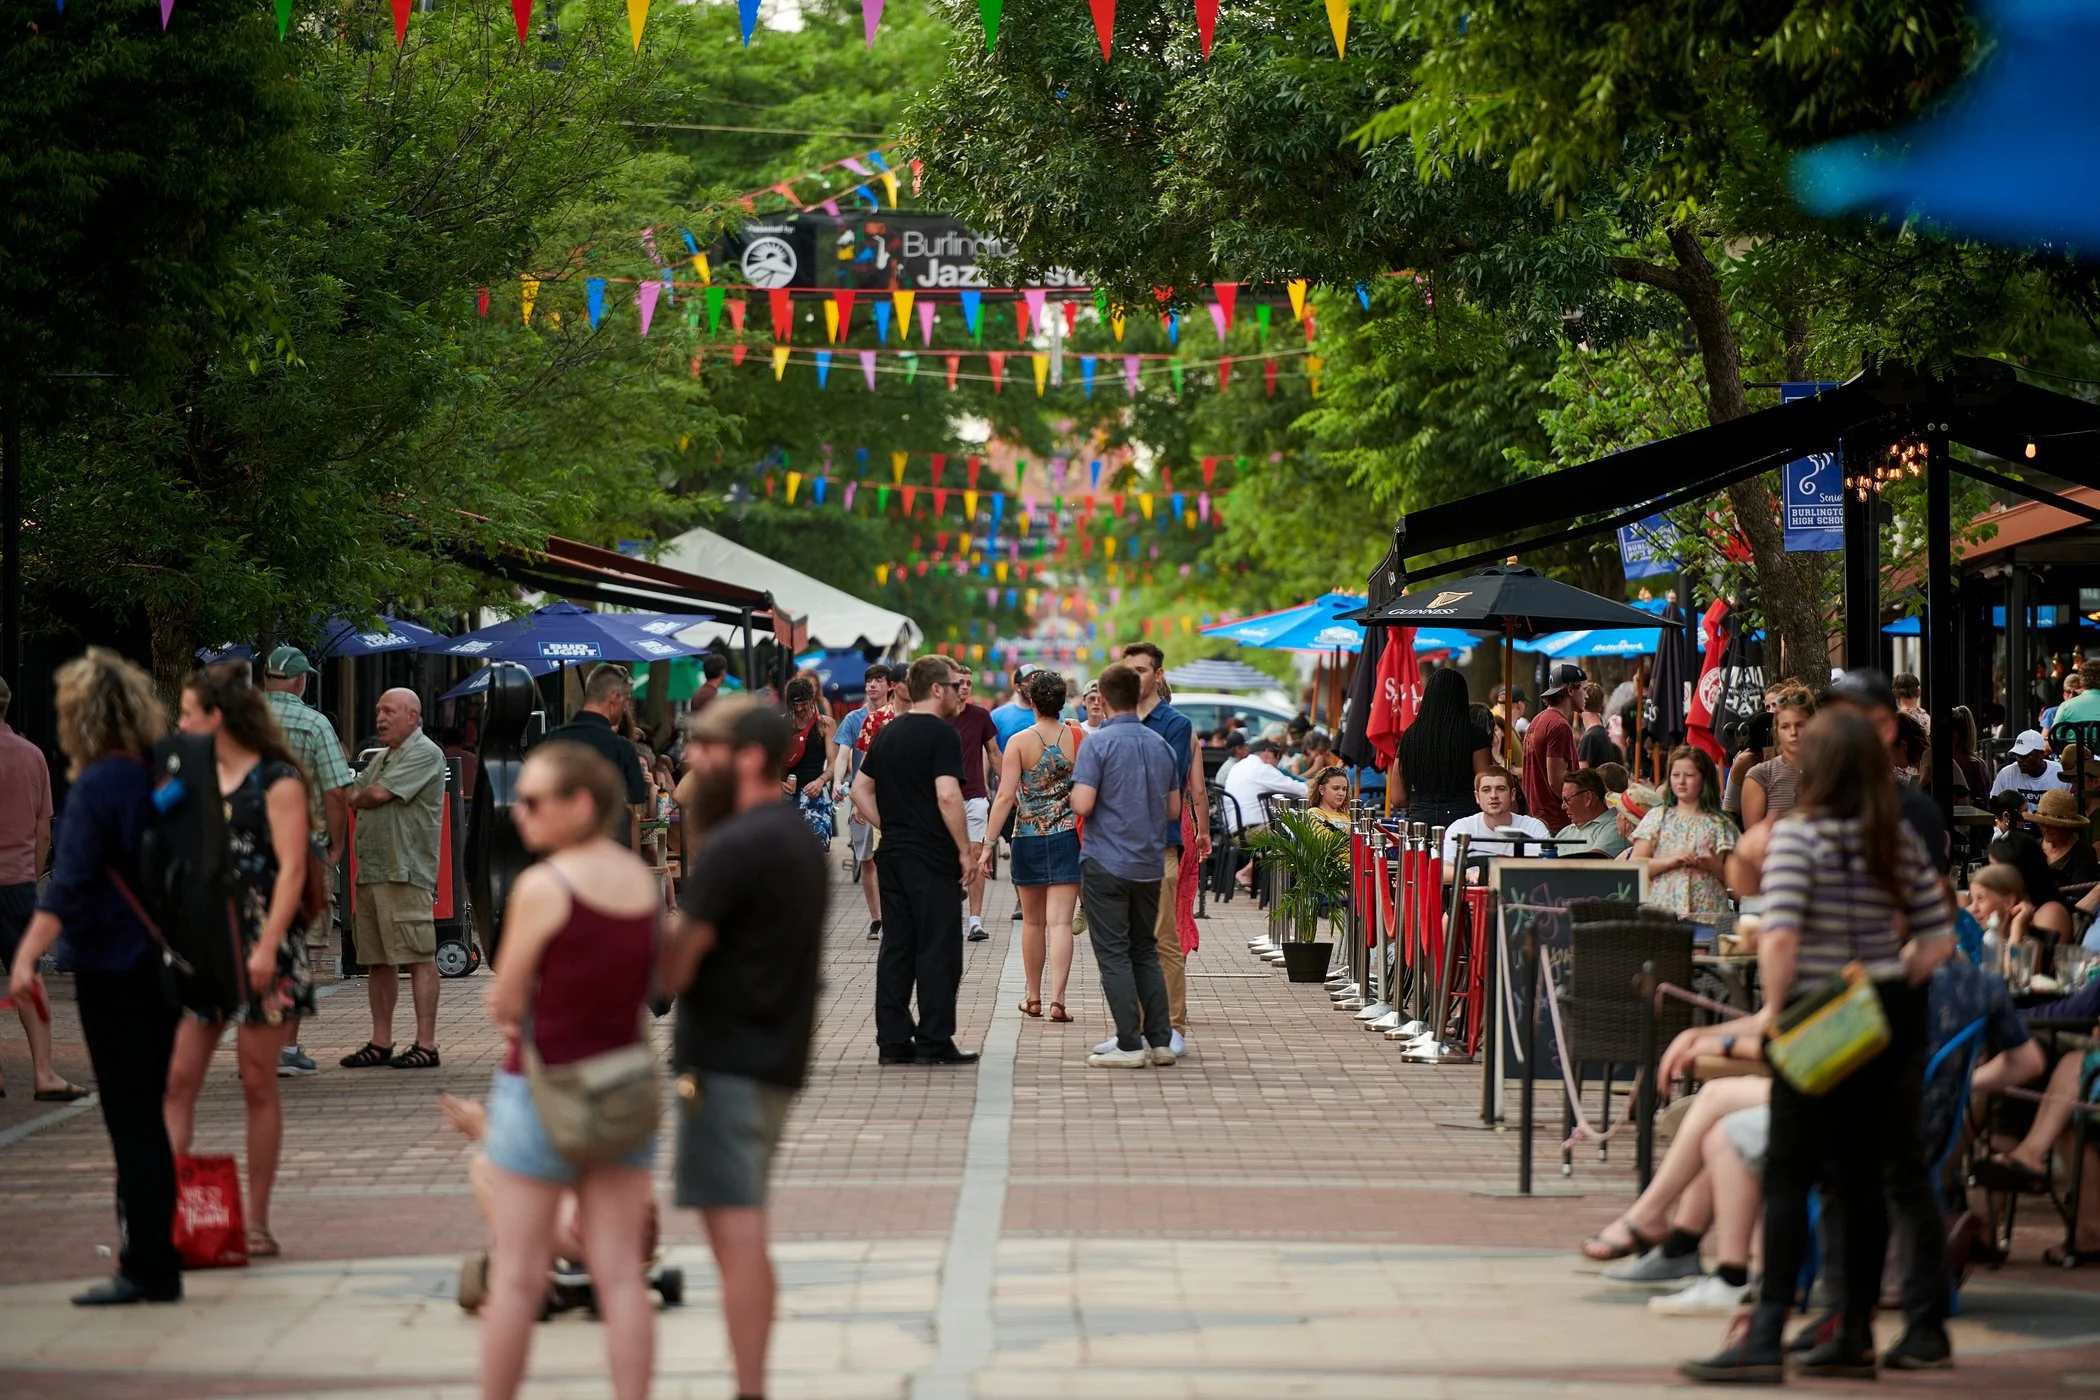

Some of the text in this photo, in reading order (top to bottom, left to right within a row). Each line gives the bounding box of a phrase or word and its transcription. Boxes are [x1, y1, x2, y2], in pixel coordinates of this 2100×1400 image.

[902, 230, 1020, 258] Burlingto
[1819, 492, 1843, 503] Senio
[1791, 508, 1844, 517] BURLINGTO
[1792, 516, 1844, 525] HIGH SCHO
[1388, 608, 1459, 616] GUINNESS
